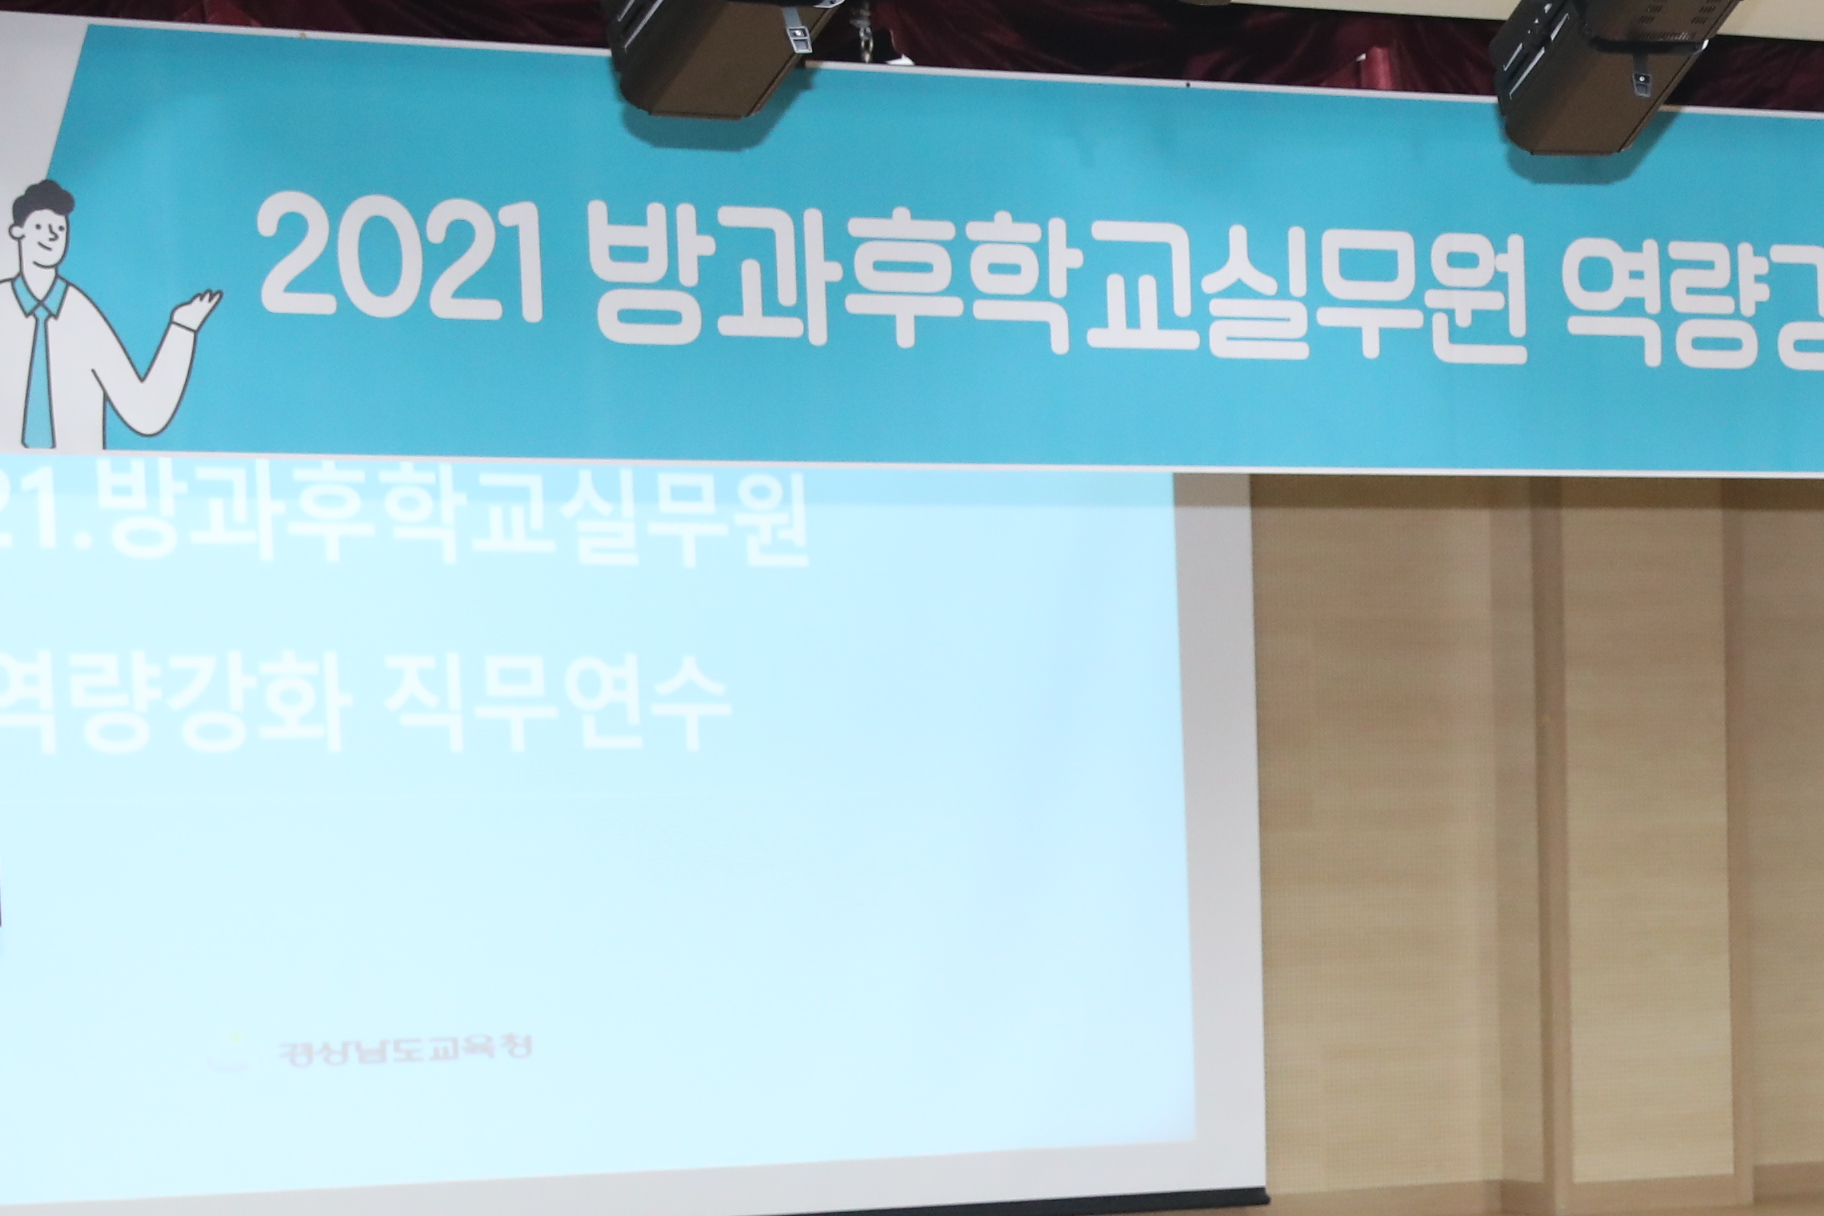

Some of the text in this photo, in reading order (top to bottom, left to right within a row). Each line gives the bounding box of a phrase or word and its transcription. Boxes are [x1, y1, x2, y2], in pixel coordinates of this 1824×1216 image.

[256, 190, 543, 324] 2021
[587, 199, 1529, 365] 방과후학교실무원
[0, 648, 733, 755] 역량강화 직무연수
[278, 1032, 534, 1070] 경상남도교육청
